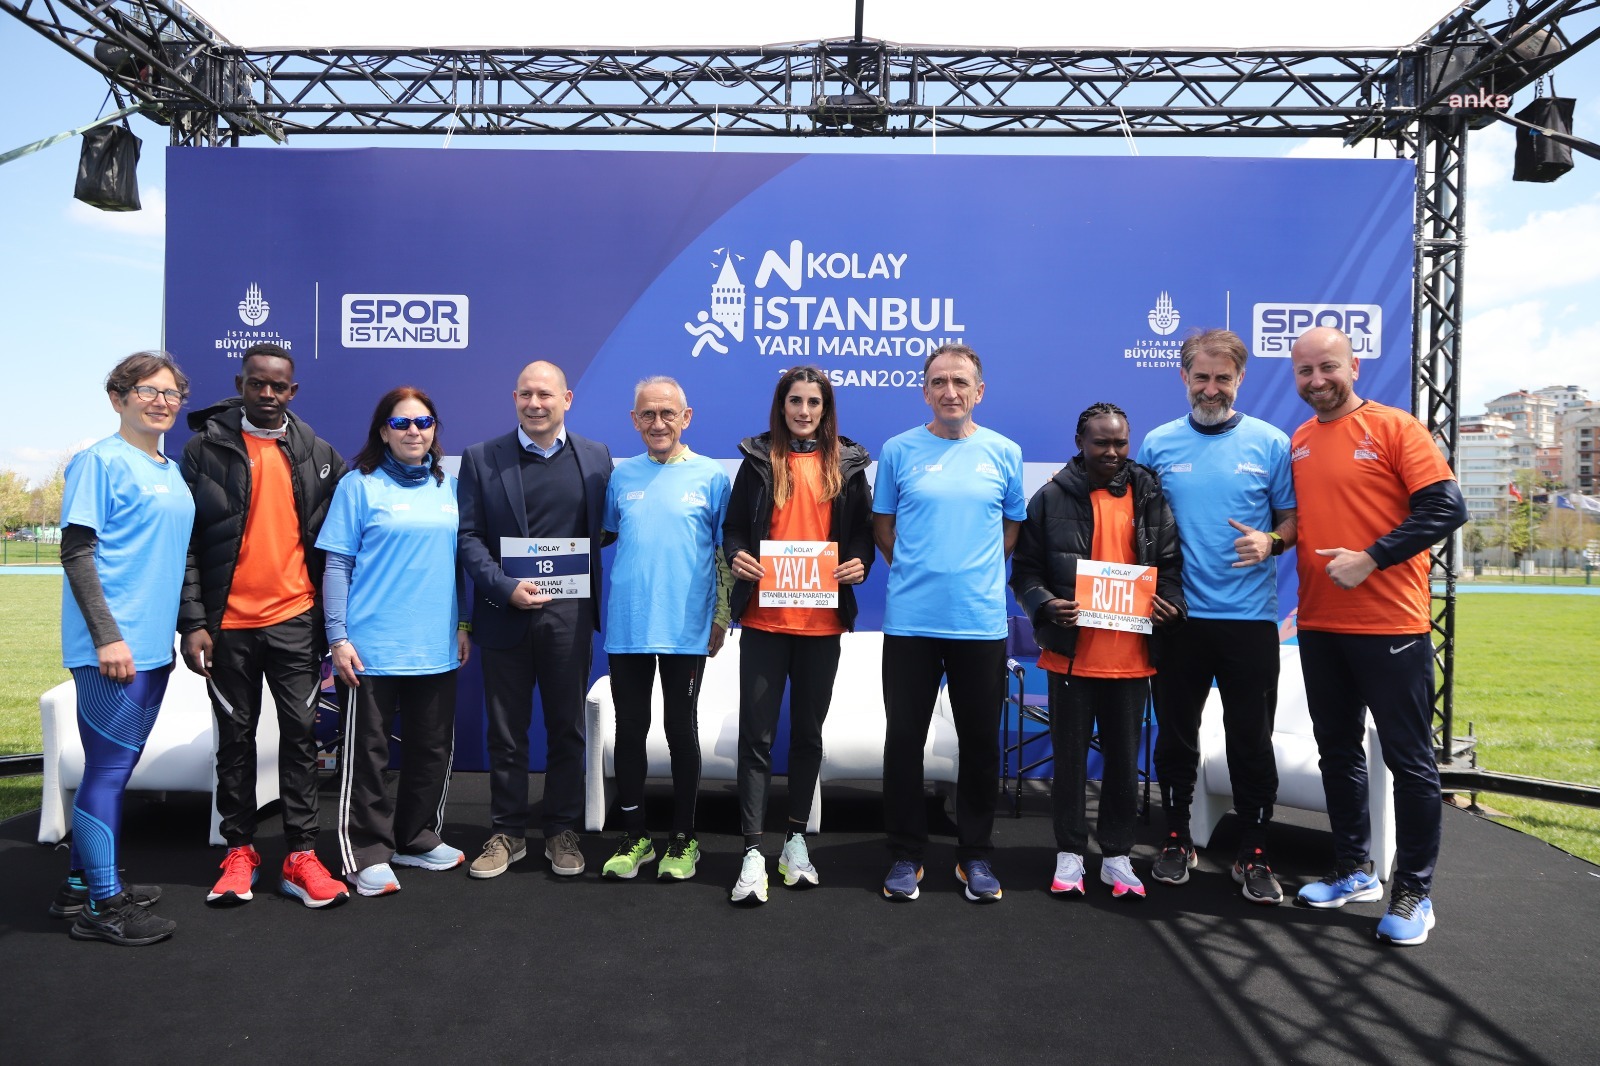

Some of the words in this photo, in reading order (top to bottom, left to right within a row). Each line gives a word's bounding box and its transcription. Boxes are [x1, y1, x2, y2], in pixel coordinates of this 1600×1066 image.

[754, 239, 803, 291] N
[807, 252, 908, 279] KOLAY
[350, 300, 460, 324] SPOR
[1262, 309, 1372, 334] SPOR
[227, 330, 280, 338] İSTANBUL
[1136, 339, 1184, 347] İSTANBU
[754, 335, 810, 356] YARI
[1124, 347, 1181, 360] BÜYÜKŞE
[536, 560, 554, 573] 18
[773, 557, 821, 590] YAYLA
[1091, 578, 1135, 613] RUTH
[1079, 610, 1104, 619] STANBUL
[1117, 616, 1150, 625] MARATHON
